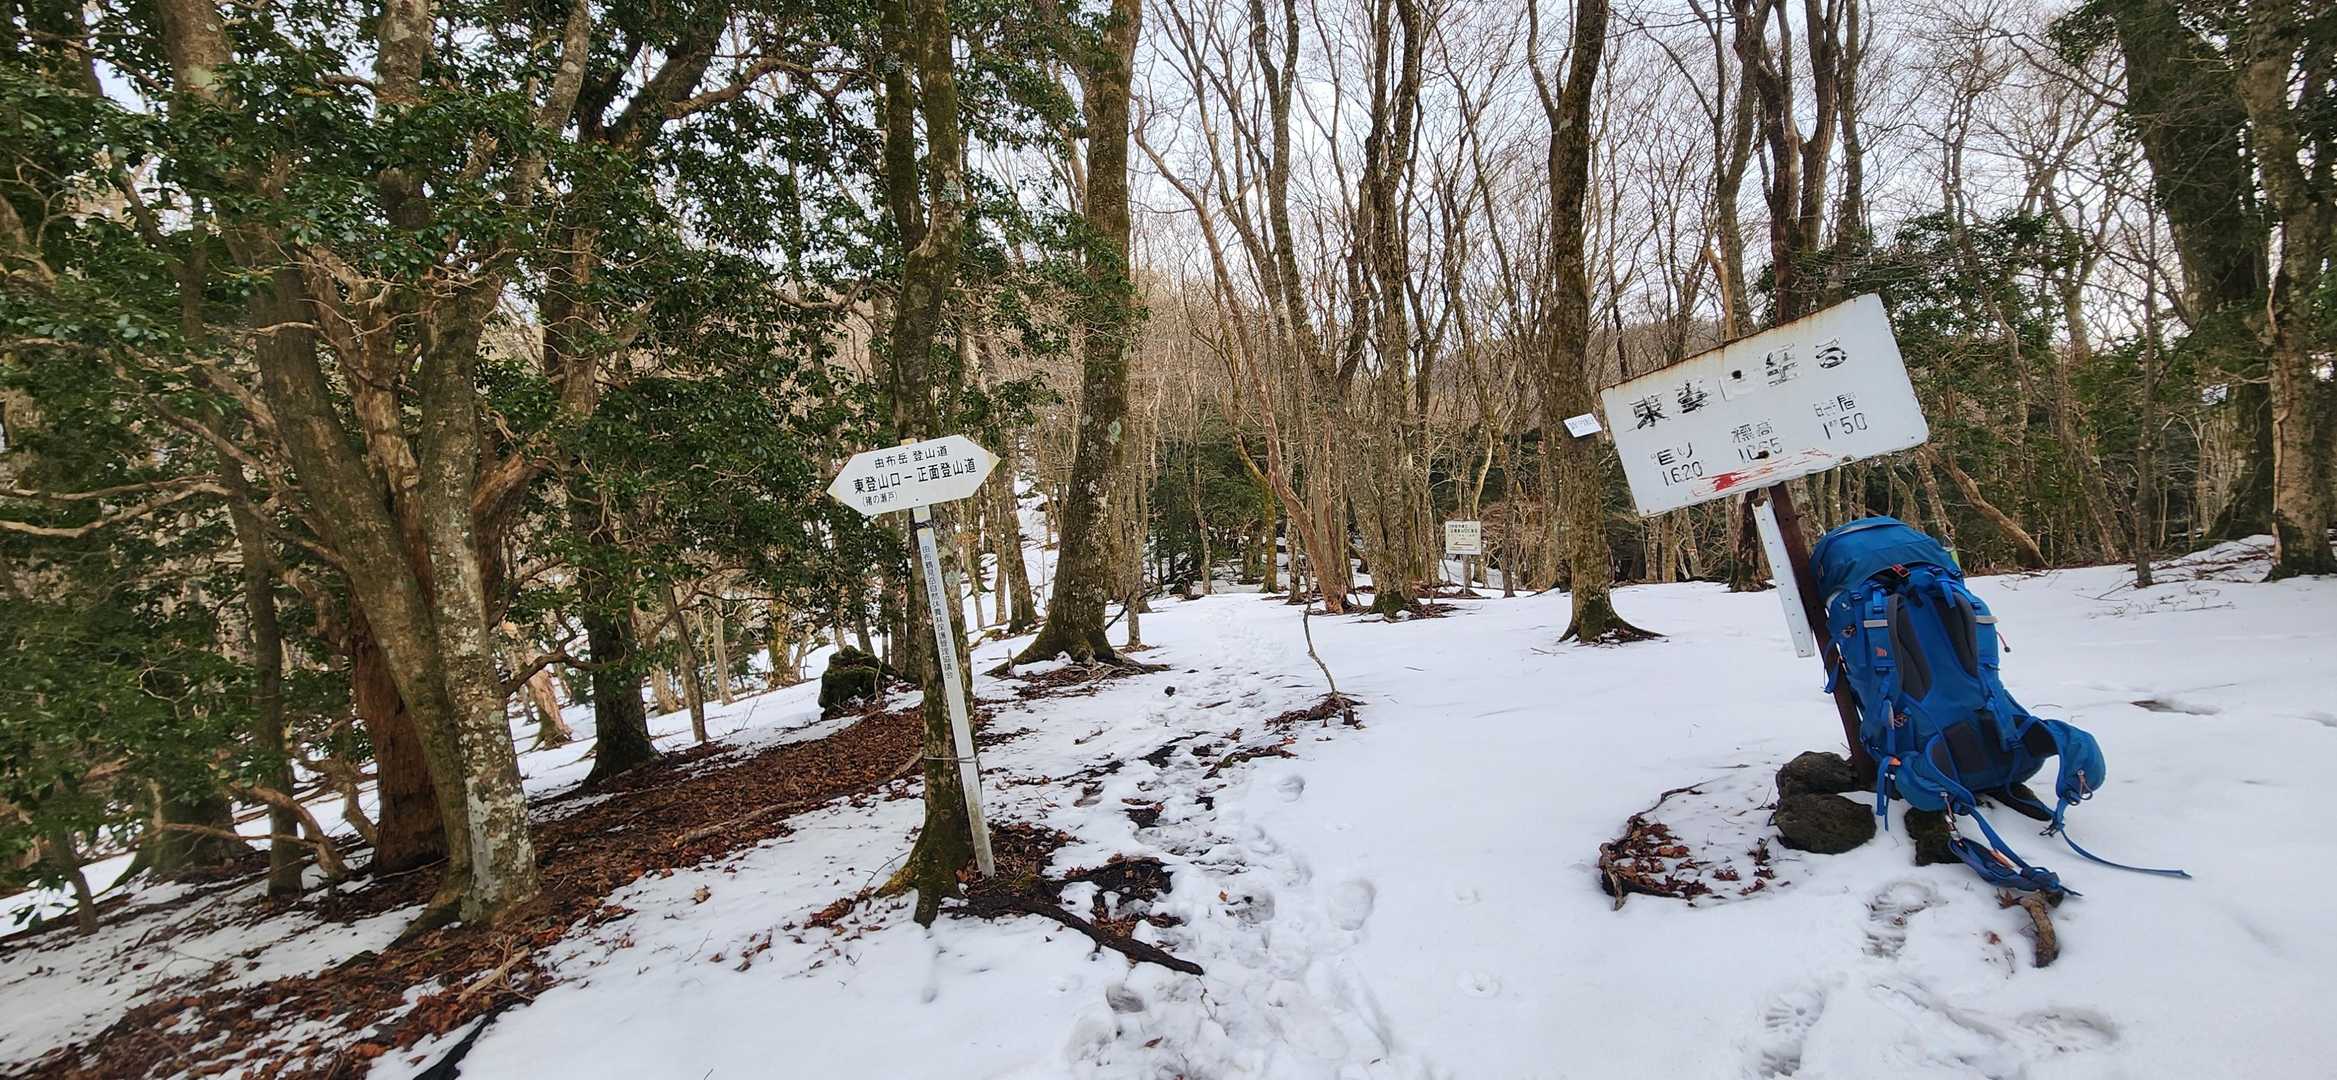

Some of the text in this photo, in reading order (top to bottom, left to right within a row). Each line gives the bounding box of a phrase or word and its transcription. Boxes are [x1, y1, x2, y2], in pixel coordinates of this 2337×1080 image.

[875, 445, 948, 469] 由布岳 登山道
